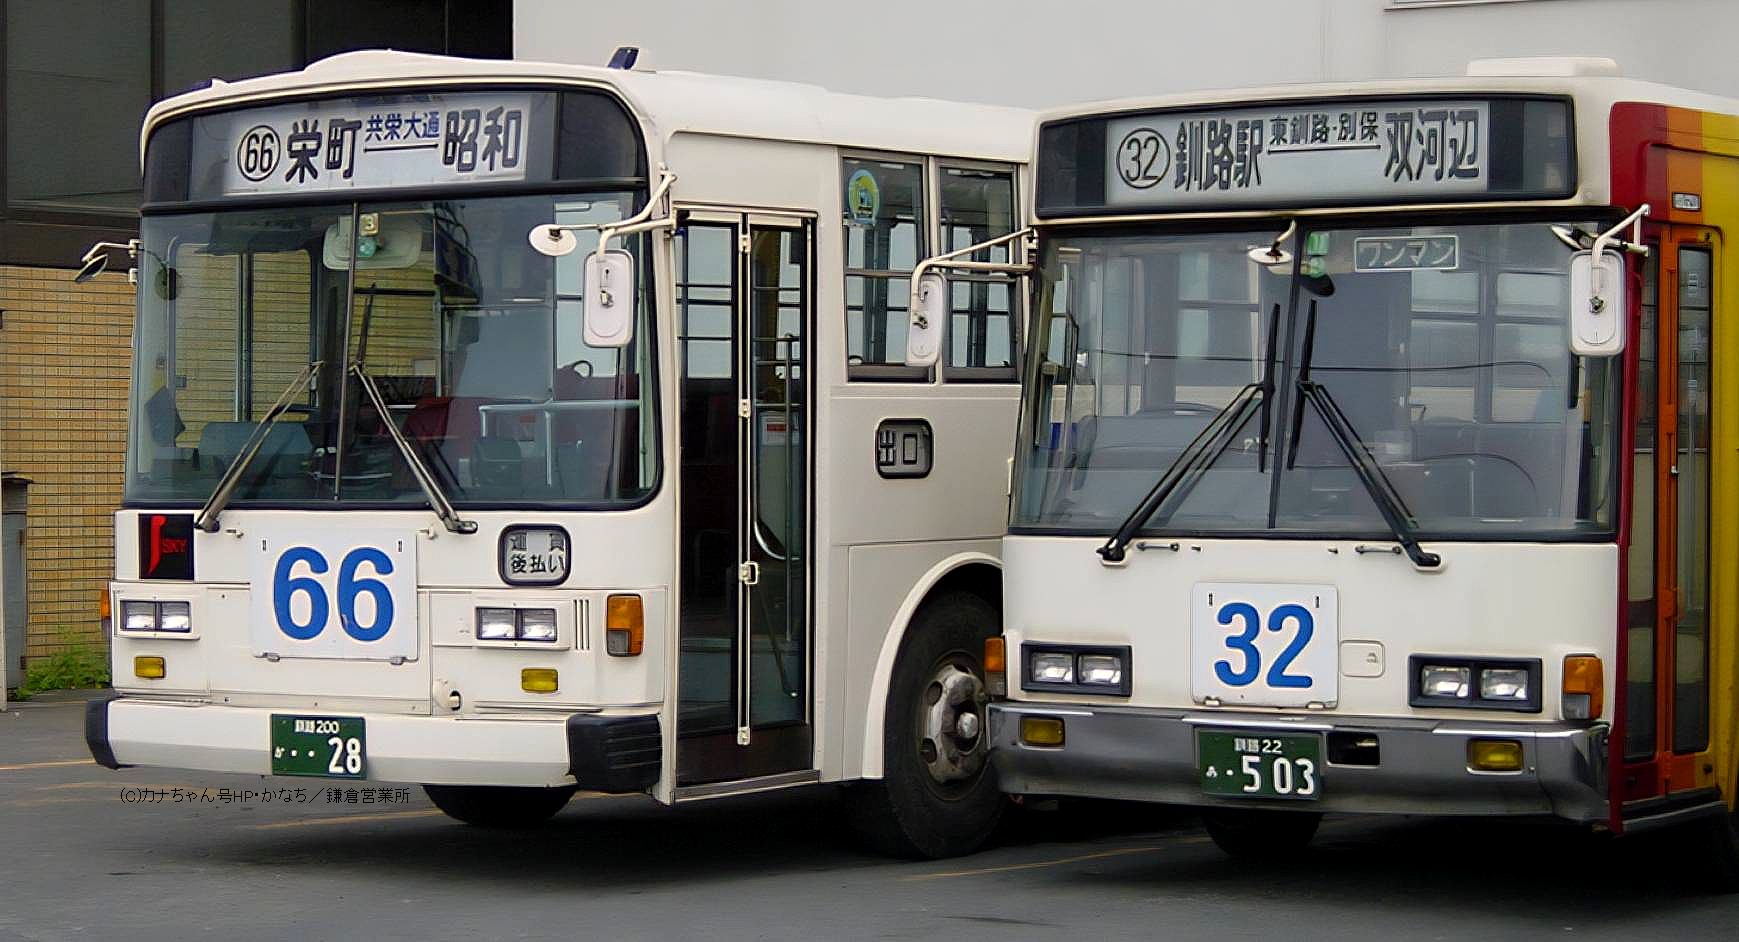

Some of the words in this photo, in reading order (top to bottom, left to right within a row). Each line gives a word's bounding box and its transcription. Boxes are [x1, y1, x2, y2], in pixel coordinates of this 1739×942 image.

[241, 130, 278, 177] 66
[285, 119, 362, 184] 栄町
[365, 112, 440, 141] 共栄大通
[442, 106, 522, 173] 昭和
[1121, 133, 1165, 185] 32
[1174, 119, 1263, 191] 釧路駅
[1384, 109, 1480, 181] 双河辺
[1357, 239, 1457, 267] ワンマン
[879, 430, 918, 465] 出口
[272, 545, 395, 642] 66
[511, 553, 565, 574] 後払い
[1214, 602, 1314, 688] 32
